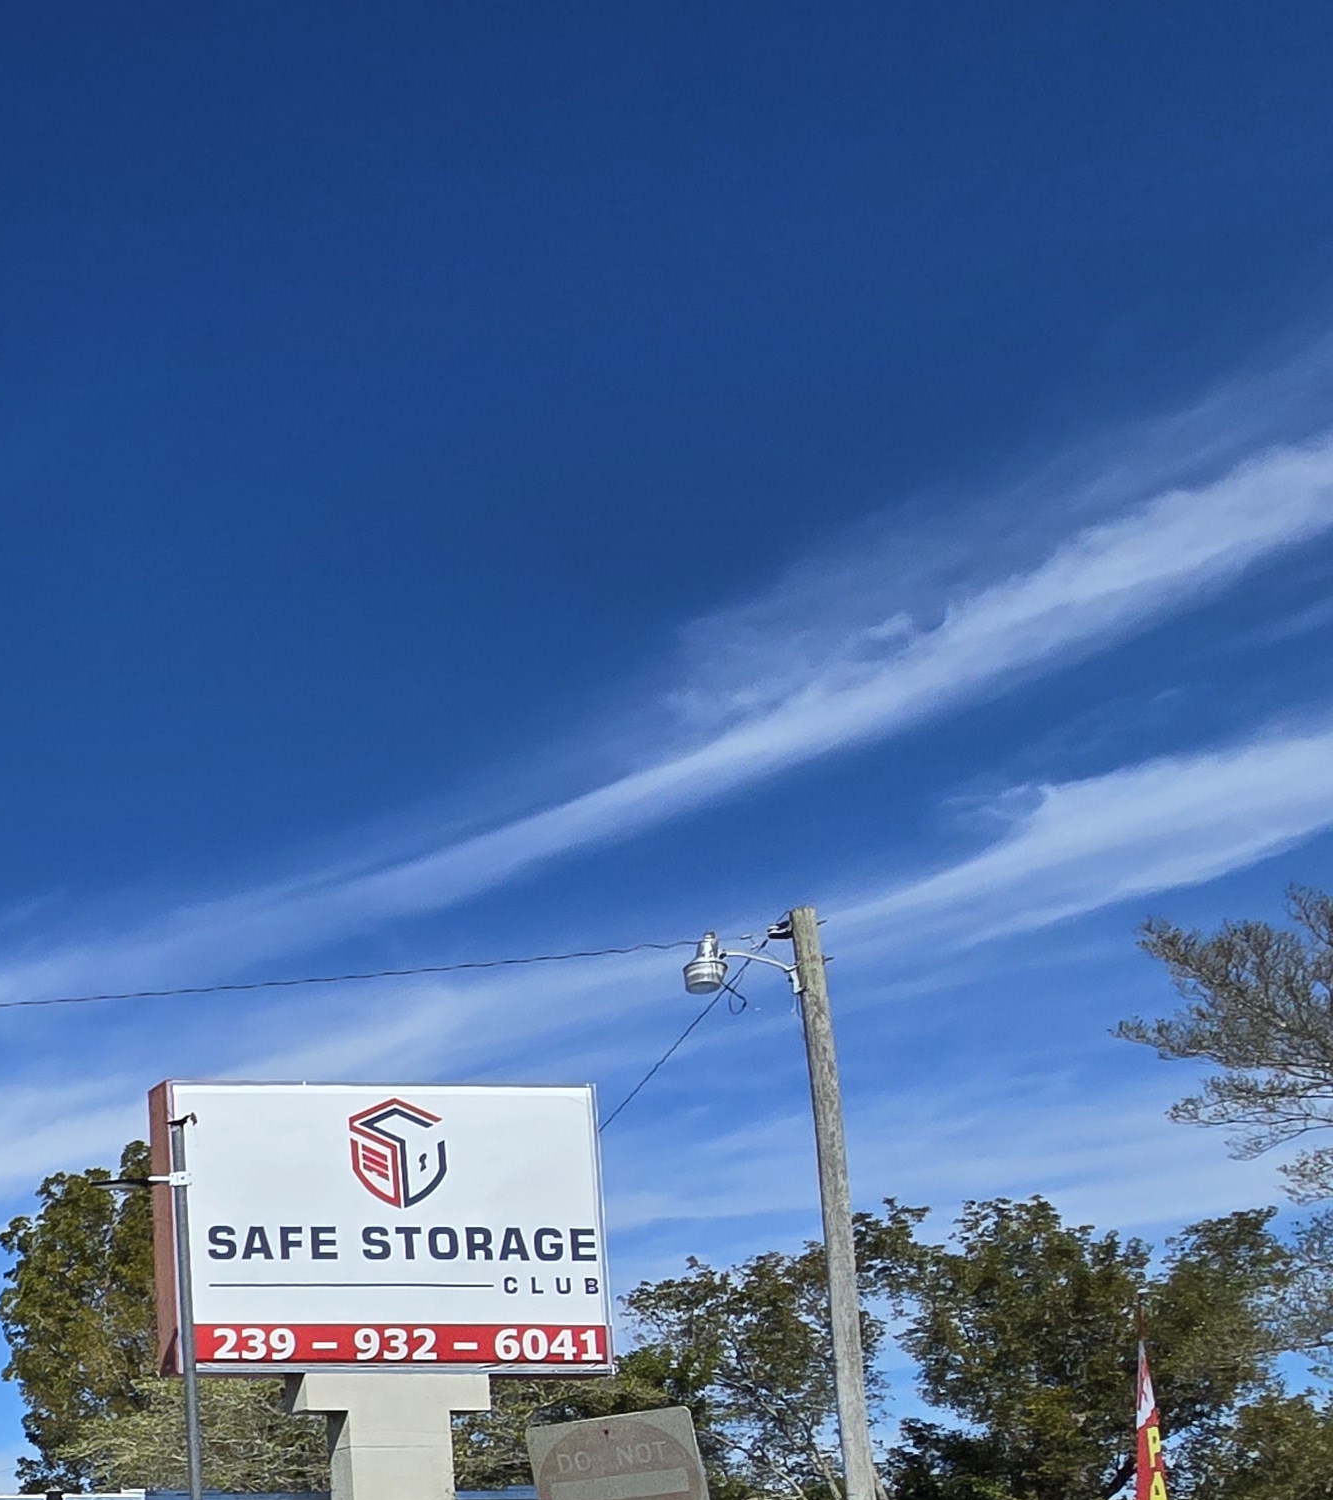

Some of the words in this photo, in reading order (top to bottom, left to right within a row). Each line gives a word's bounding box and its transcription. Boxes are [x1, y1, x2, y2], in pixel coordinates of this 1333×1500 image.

[208, 1225, 338, 1260] SAFE
[361, 1226, 598, 1262] STORAGE
[503, 1276, 600, 1295] CLUB
[213, 1328, 296, 1360] 239
[354, 1328, 437, 1361] 932
[494, 1328, 603, 1361] 6041
[556, 1452, 592, 1474] DO
[615, 1441, 667, 1467] NOT
